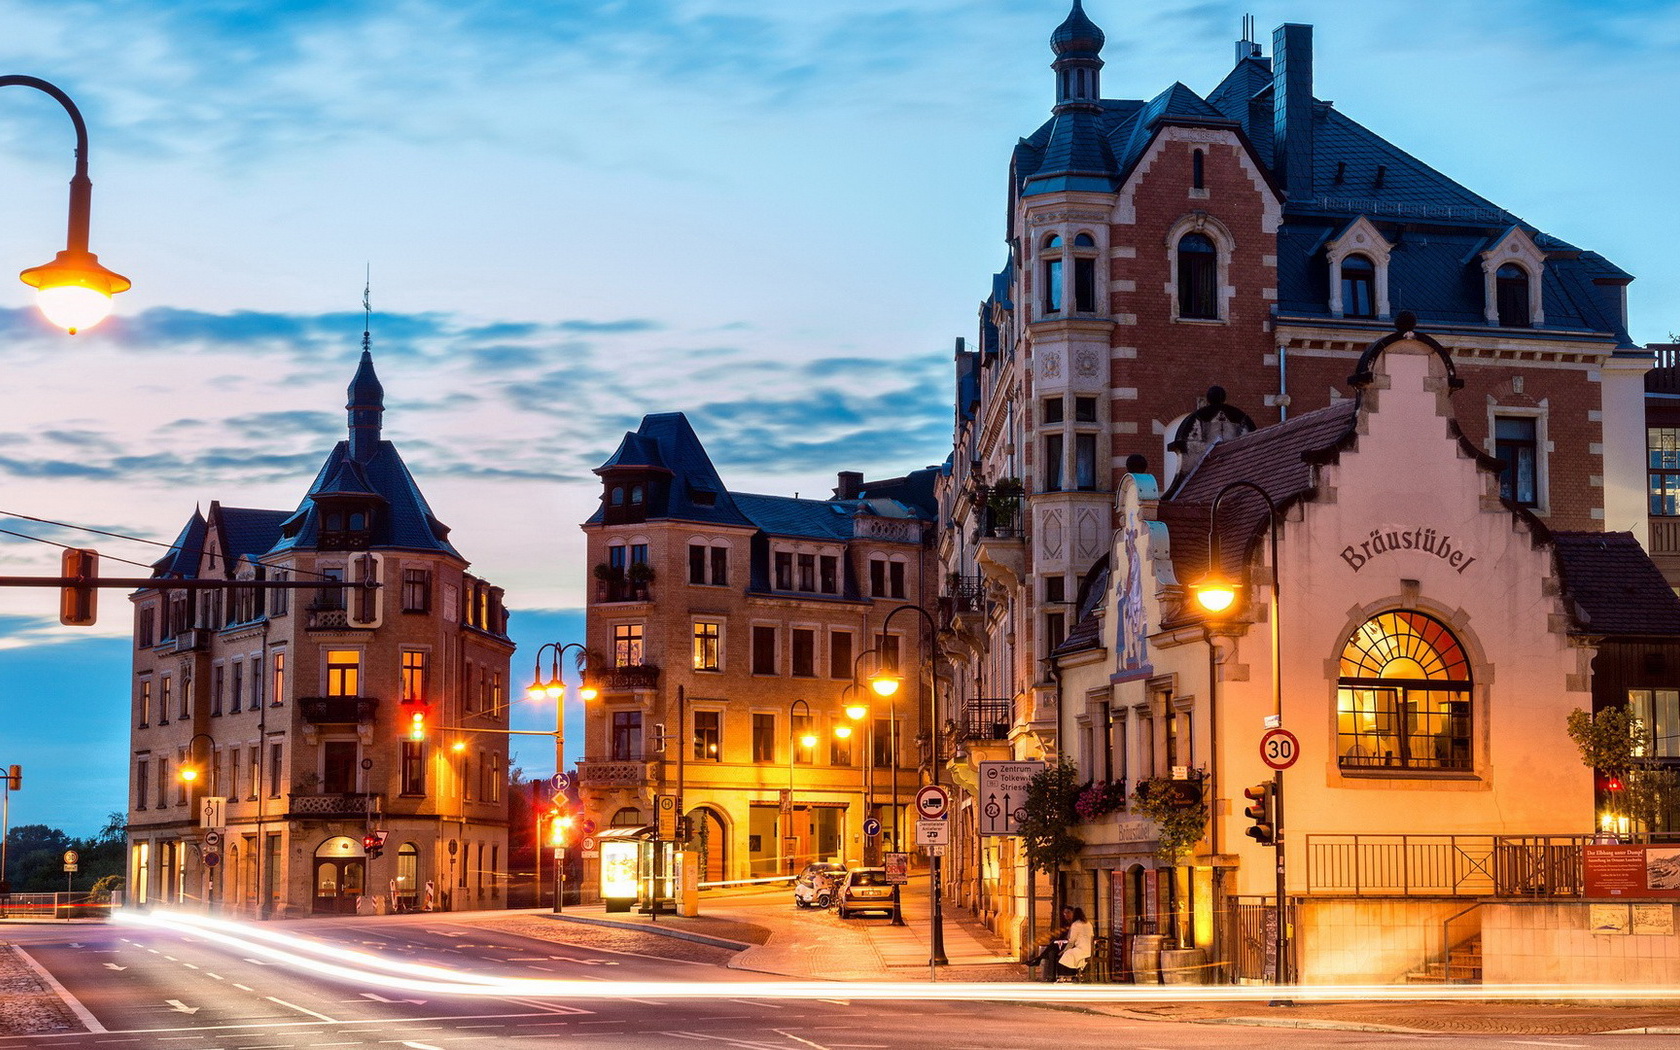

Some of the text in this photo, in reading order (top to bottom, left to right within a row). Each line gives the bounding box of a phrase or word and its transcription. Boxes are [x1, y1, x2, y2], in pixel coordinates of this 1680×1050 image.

[1340, 527, 1476, 574] Bräustübel
[1268, 740, 1291, 758] 30
[1000, 765, 1032, 773] Zentrum
